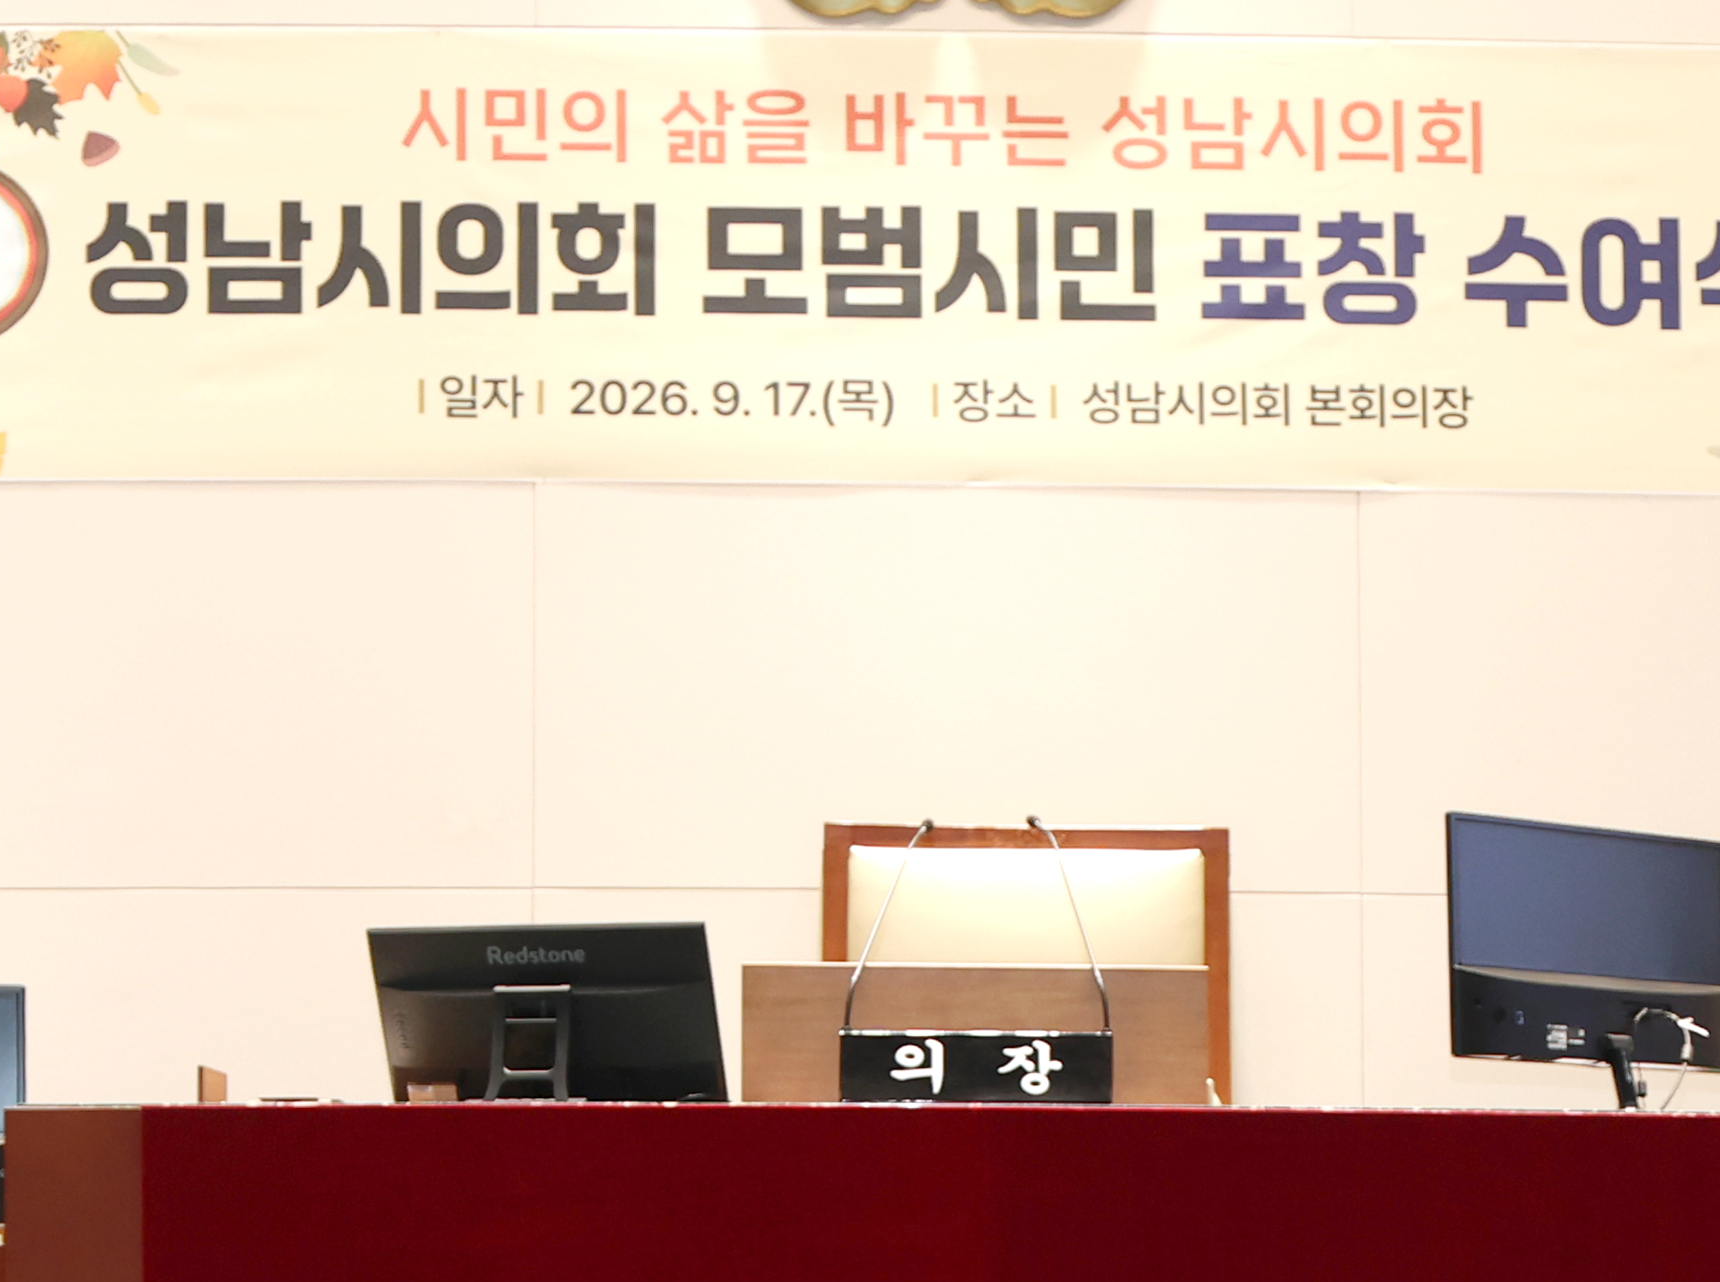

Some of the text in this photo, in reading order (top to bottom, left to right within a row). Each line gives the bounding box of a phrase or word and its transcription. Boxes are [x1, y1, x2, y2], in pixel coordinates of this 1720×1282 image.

[402, 88, 1483, 174] 시민의 삶을 바꾸는 성남시의회
[85, 199, 656, 317] 성남시의회
[701, 205, 1157, 322] 모범시민
[1201, 211, 1426, 326] 표창
[439, 374, 525, 420] 일자
[953, 379, 1037, 423] 장소
[1082, 380, 1291, 426] 성남시의회
[1305, 383, 1474, 429] 본회의장
[486, 945, 585, 965] Redstone
